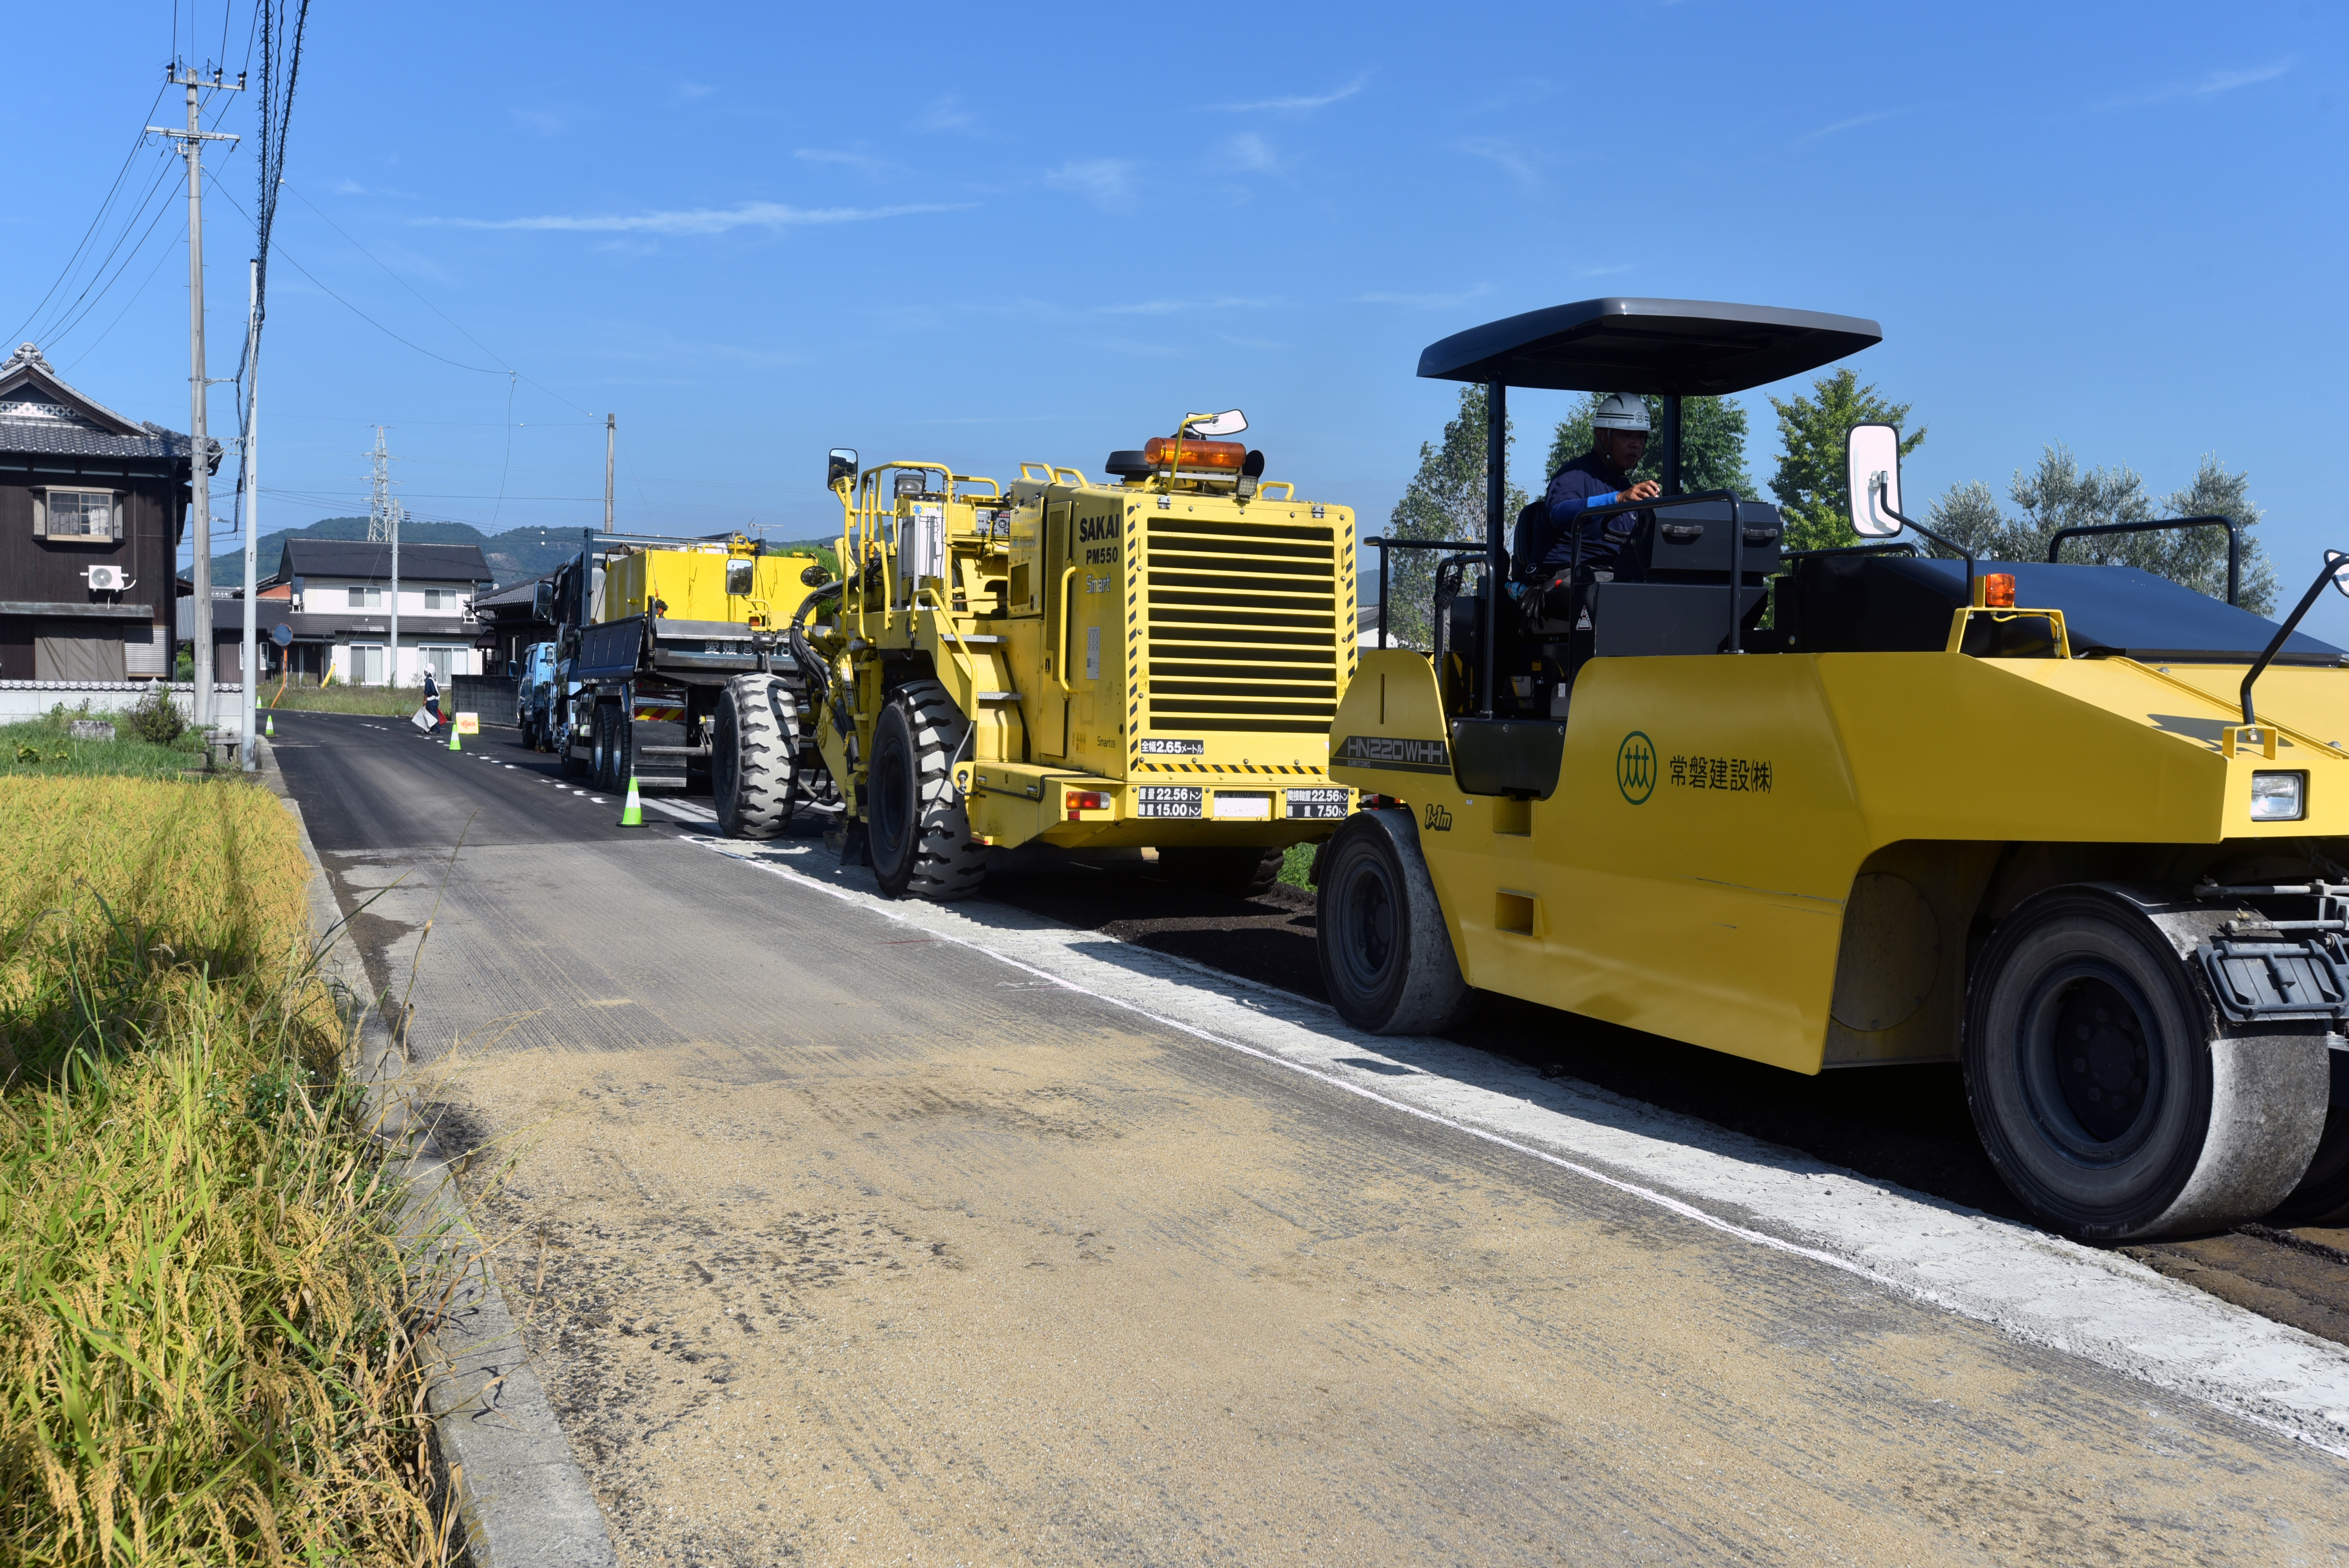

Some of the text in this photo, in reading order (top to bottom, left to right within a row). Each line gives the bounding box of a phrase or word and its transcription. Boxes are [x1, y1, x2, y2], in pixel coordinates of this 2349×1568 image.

[1079, 514, 1119, 543] SAKAI
[1086, 546, 1118, 565] PM550
[1086, 572, 1110, 594] Smart
[1141, 741, 1203, 754] 全幅2.65メートル
[1347, 737, 1443, 763] HN220WHH
[1347, 759, 1371, 768] SUMITOMO
[1670, 755, 1772, 795] 常磐建設(株)
